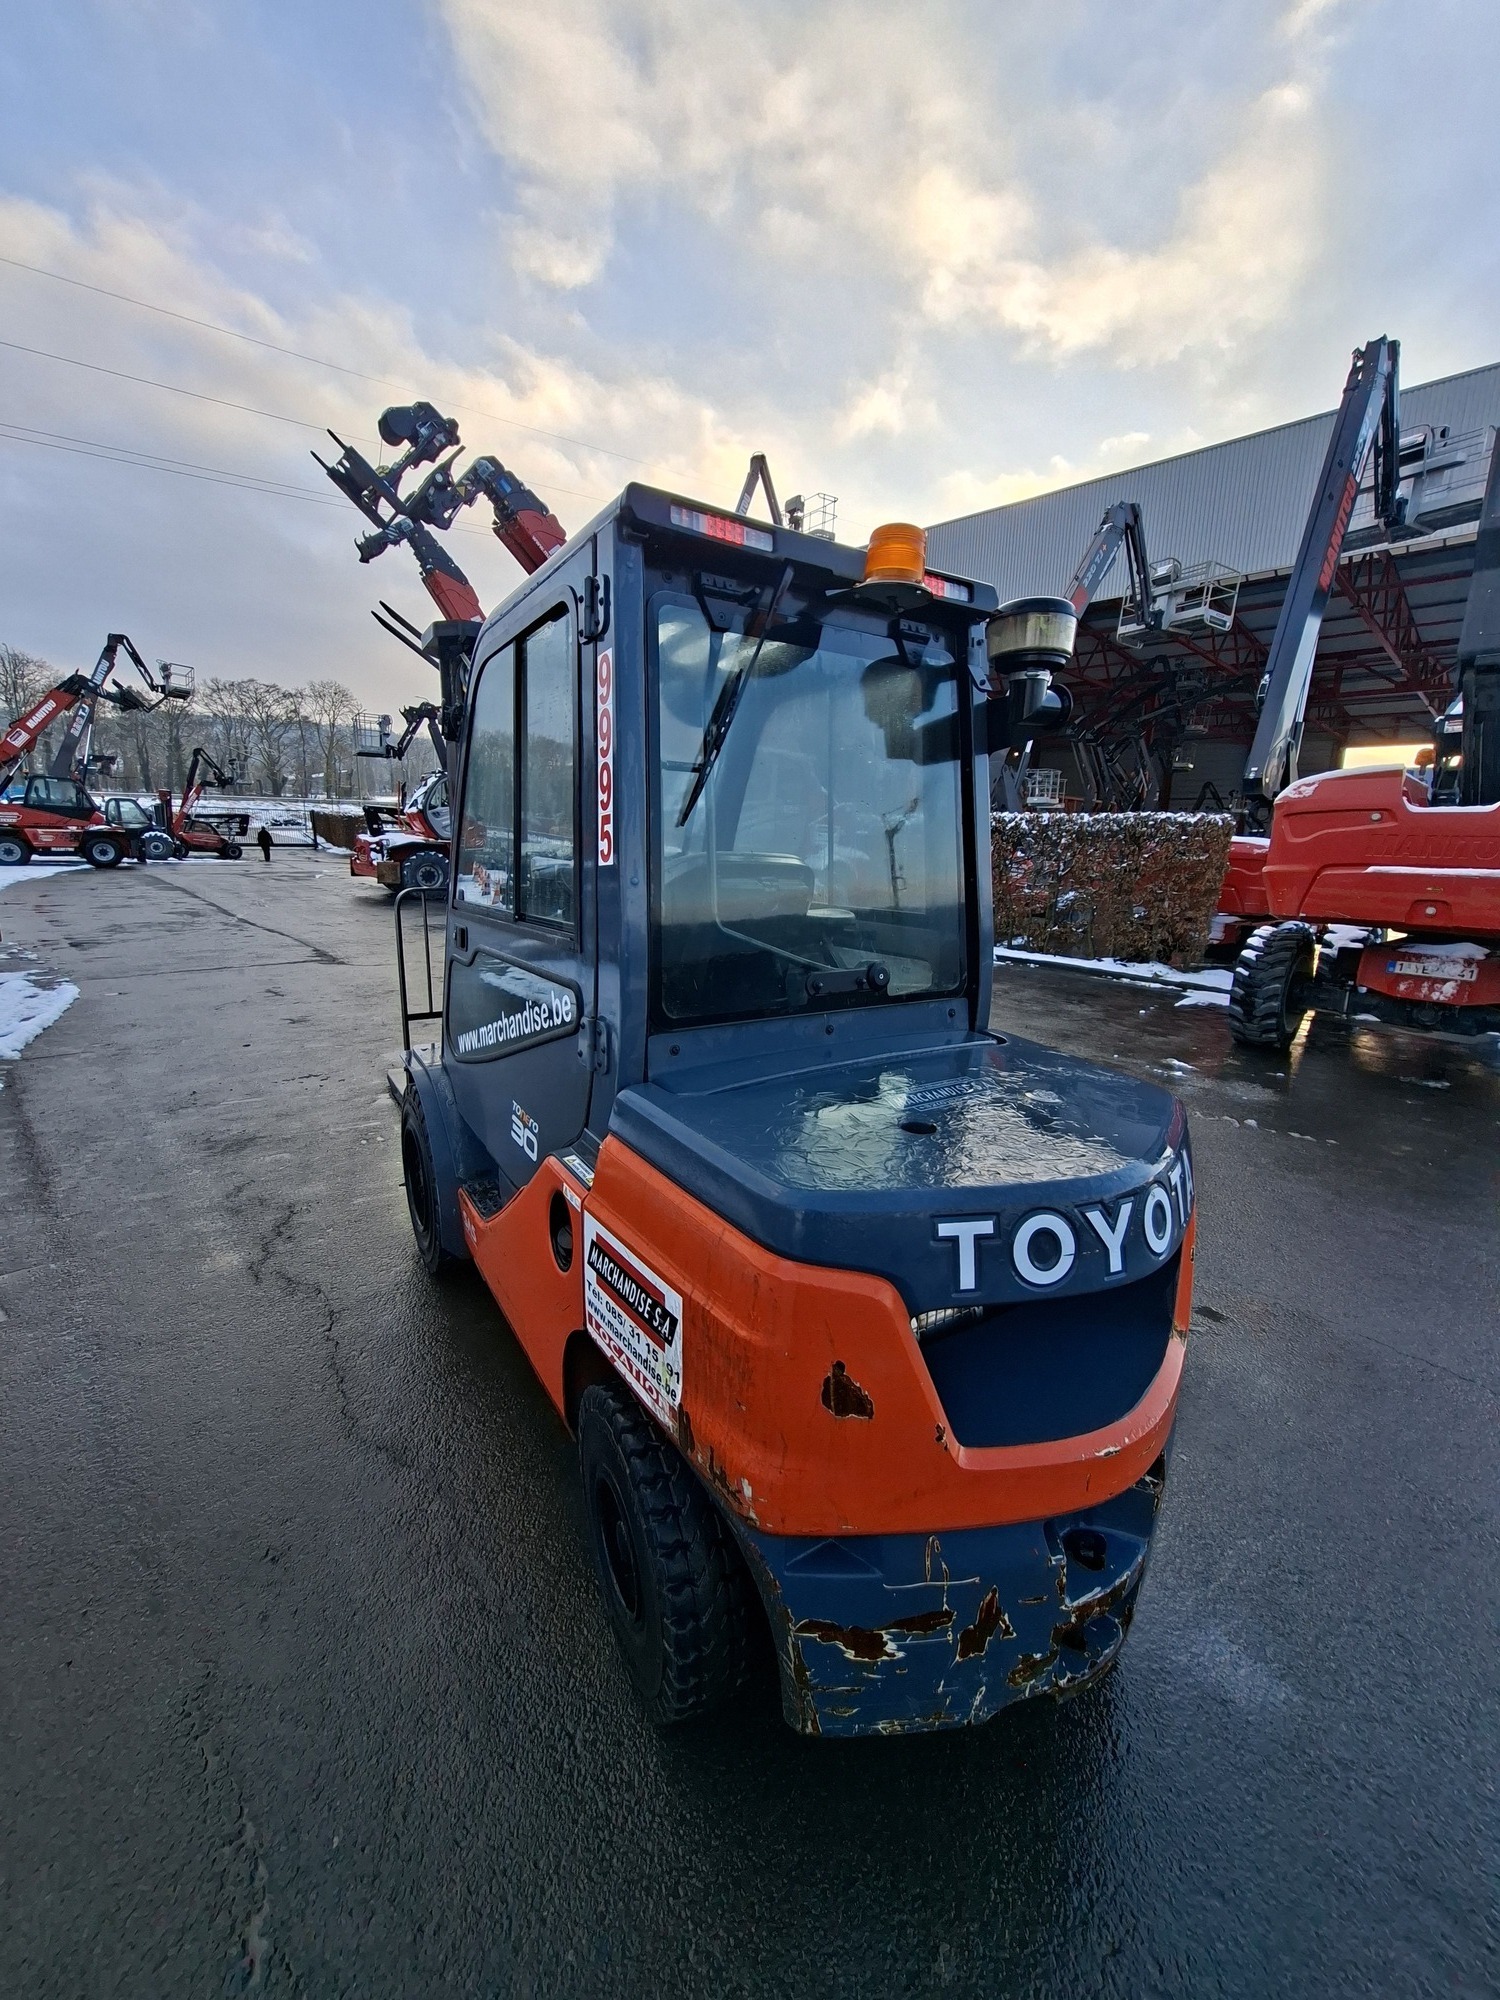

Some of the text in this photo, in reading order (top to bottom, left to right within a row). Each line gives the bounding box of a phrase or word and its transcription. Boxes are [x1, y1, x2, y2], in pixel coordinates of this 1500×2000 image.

[1319, 472, 1357, 592] MANITOU
[25, 699, 57, 729] MANITOU
[599, 653, 612, 863] 9995
[457, 990, 572, 1053] www.marchandise.be
[511, 1114, 538, 1162] 30
[938, 1149, 1195, 1290] TOYOTA
[586, 1279, 681, 1385] Tél: 085/ 31 15 91
[590, 1245, 673, 1341] MARCHANDISE S.A.
[587, 1297, 678, 1402] www.marchandise.be
